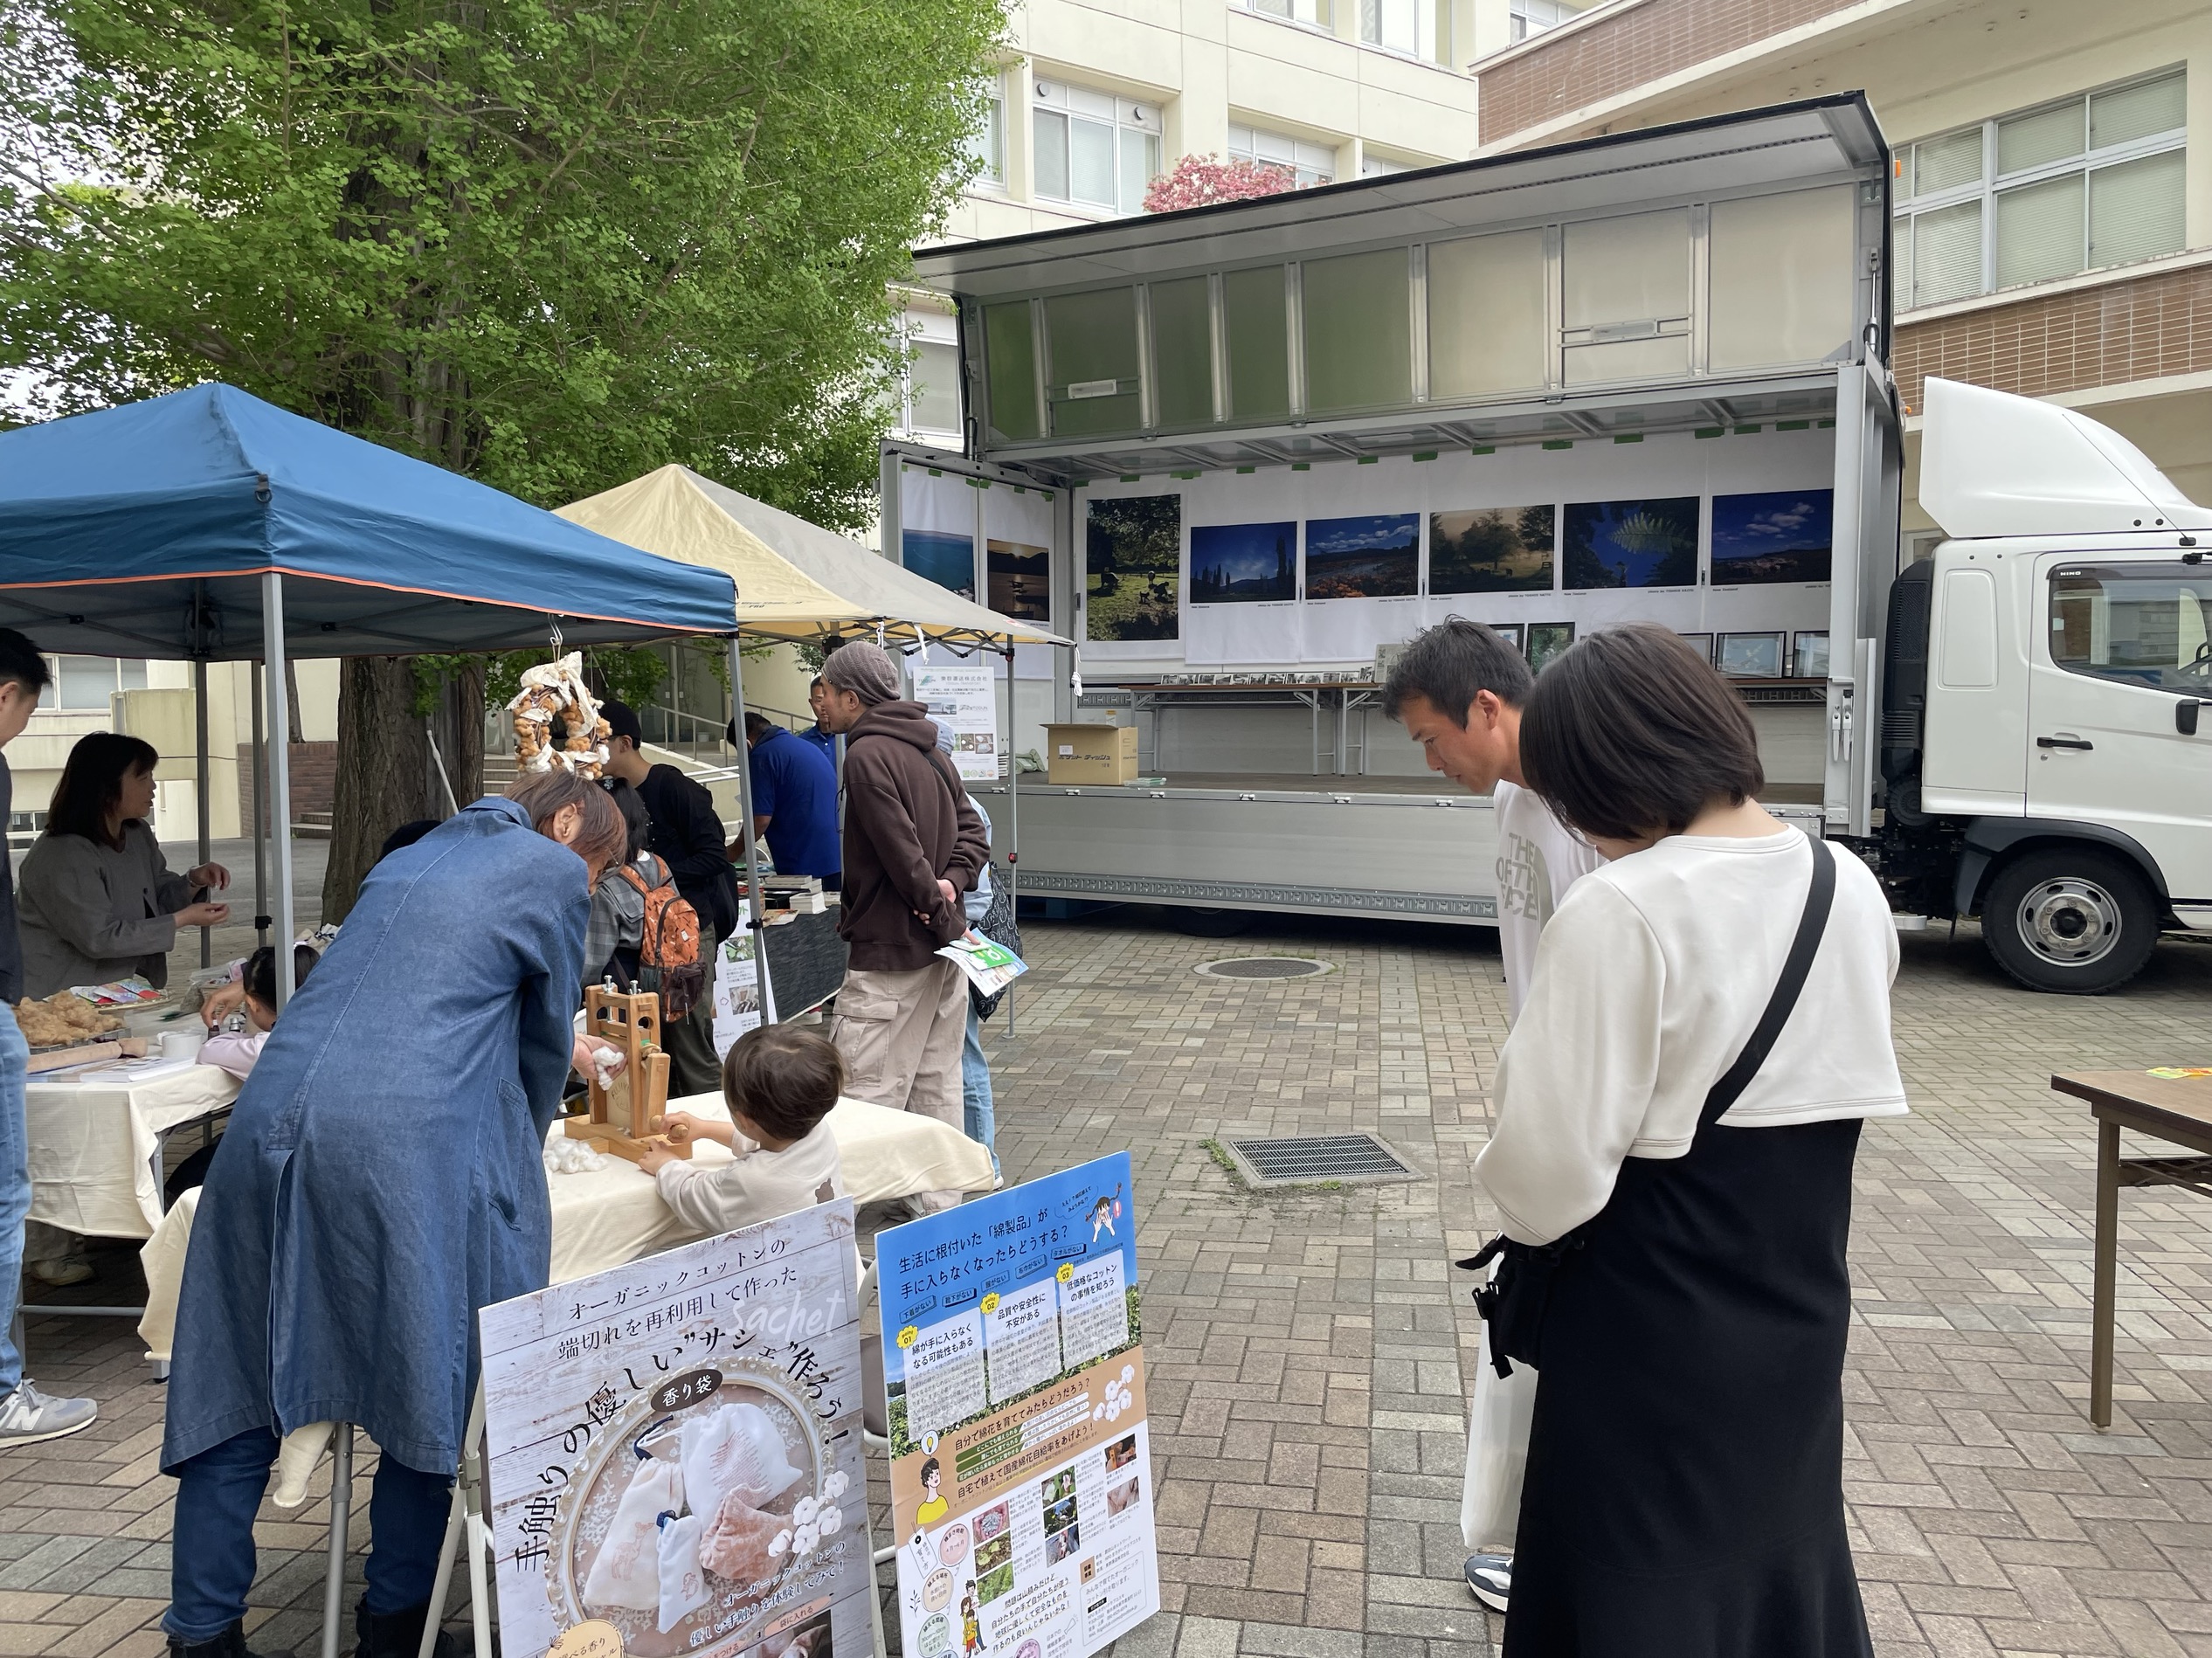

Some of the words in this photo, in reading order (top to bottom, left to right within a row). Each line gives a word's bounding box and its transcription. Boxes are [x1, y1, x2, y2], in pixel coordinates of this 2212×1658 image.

[1509, 832, 1534, 863] THE
[898, 1206, 1047, 1275] 生活に根付いた「綿製品」が
[569, 1238, 786, 1321] オーガニックコットンの
[900, 1224, 1068, 1301] 手に入らなくなったらどうする？
[1061, 1271, 1069, 1280] 03
[1066, 1262, 1117, 1291] 低価格なコットン
[986, 1301, 995, 1310] 02
[1070, 1275, 1115, 1302] の事情を知ろう
[558, 1266, 798, 1360] 端切れを再利用して作った
[902, 1298, 931, 1321] 下着がない
[997, 1291, 1046, 1321] 品質や安全性に
[1005, 1307, 1040, 1330] 不安がある
[903, 1335, 912, 1345] 01
[911, 1322, 971, 1357] 綿が手に入らなく
[912, 1336, 973, 1370] なる可能性もある
[662, 1374, 713, 1407] 香り袋
[7, 1406, 45, 1431] N
[954, 1377, 1089, 1451] 自分で綿花を育ててみたらどうだろう？
[976, 1427, 1018, 1453] どこにでも植えられる
[957, 1421, 1093, 1499] 自宅で植えて国産綿花自給率をあげよう！
[724, 1539, 846, 1607] オーガニックコットンの
[688, 1558, 846, 1648] 優しい手触りを体験してみて！
[991, 1575, 1069, 1630] 自分たちの手で自分たちが使う
[1004, 1572, 1055, 1610] 問題は山積みだけど
[779, 1606, 814, 1627] 袋に入れる
[992, 1599, 1069, 1654] 作るのも良いんじゃないかな！
[994, 1588, 1068, 1640] 地球に優しくて安全なものを
